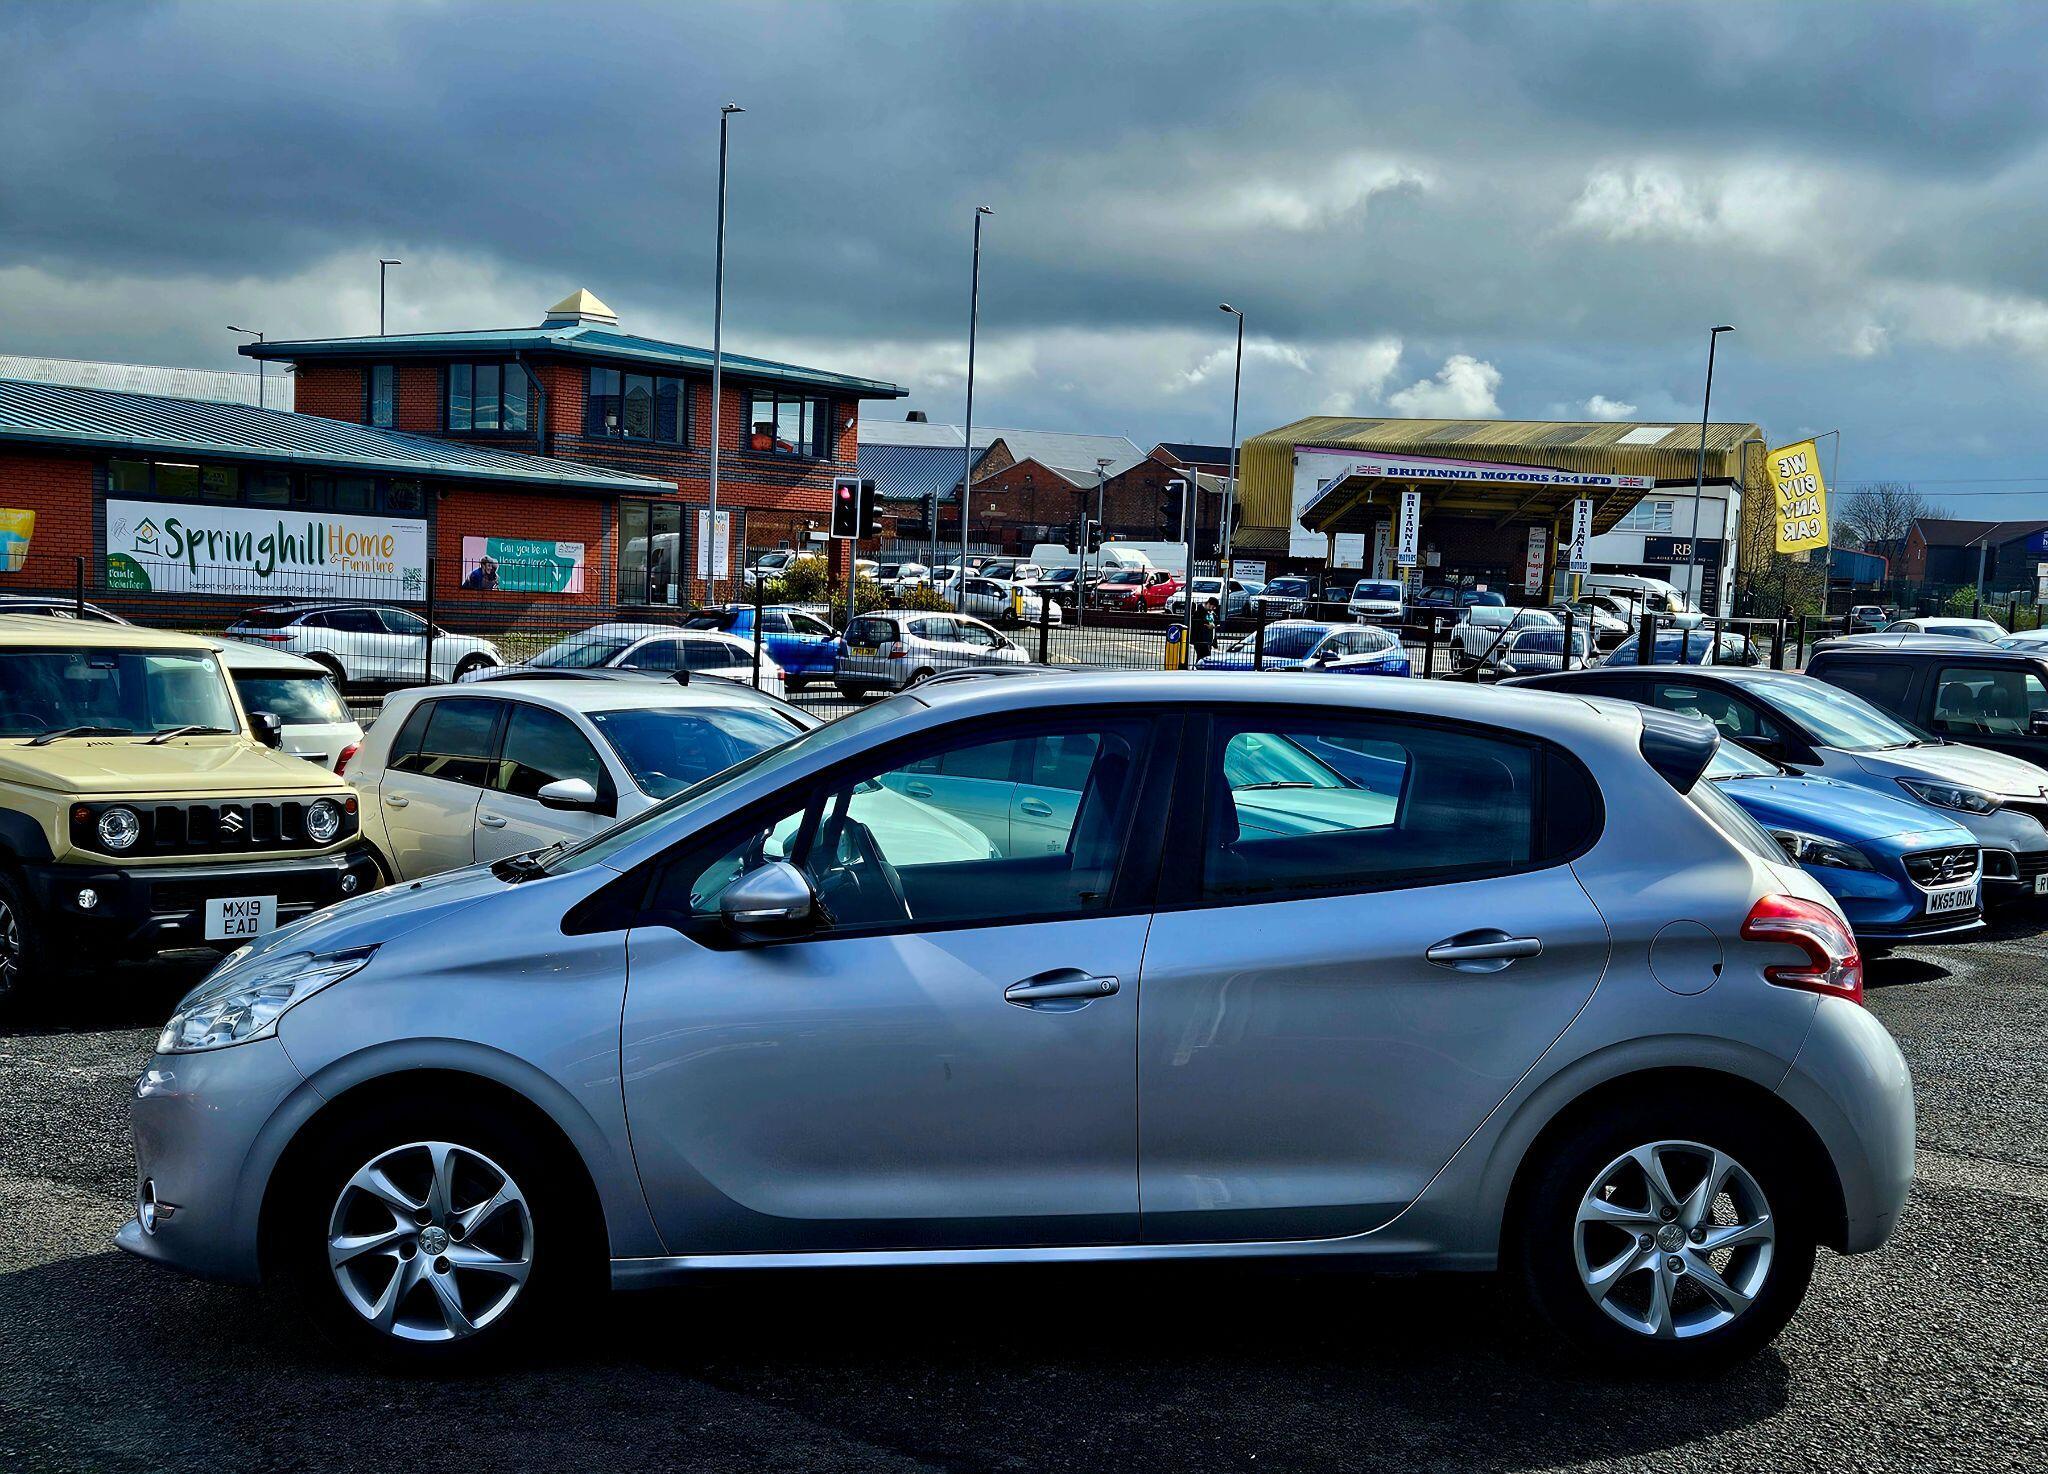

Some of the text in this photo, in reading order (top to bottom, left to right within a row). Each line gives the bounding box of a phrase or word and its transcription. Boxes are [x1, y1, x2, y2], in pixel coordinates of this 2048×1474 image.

[1387, 467, 1478, 479] BRITANNIA
[1481, 471, 1549, 482] MOTORS
[1582, 476, 1612, 485] LTD
[1404, 493, 1416, 553] BRITANNIA
[1575, 500, 1588, 560] BRITANNIA
[164, 517, 395, 577] Springhill Home
[516, 545, 530, 557] you
[531, 543, 541, 554] be
[1673, 543, 1692, 556] RB
[341, 556, 395, 573] Furniture
[1956, 888, 1975, 906] OXK
[223, 901, 261, 917] MX19
[224, 918, 258, 935] EAD
